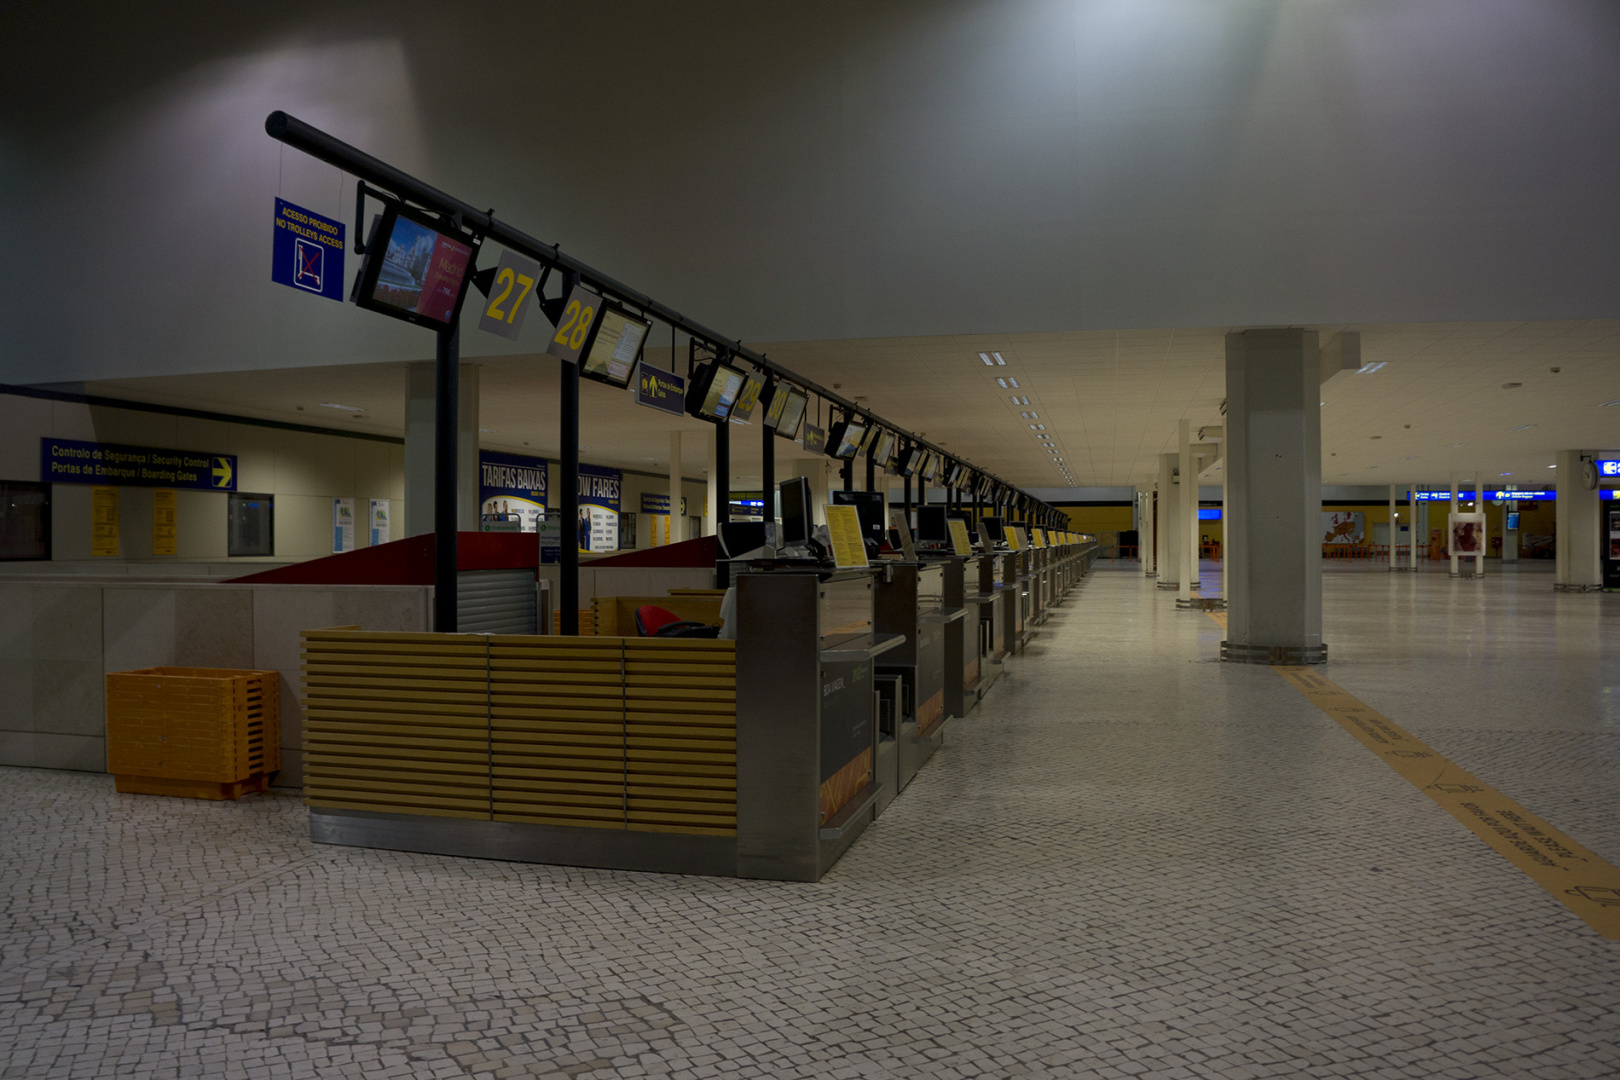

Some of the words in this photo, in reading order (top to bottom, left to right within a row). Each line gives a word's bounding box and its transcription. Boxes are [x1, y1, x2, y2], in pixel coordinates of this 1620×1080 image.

[276, 217, 286, 229] NO
[287, 221, 318, 241] TROLLEYS
[318, 234, 343, 250] ACCESS
[282, 207, 308, 224] ACESSO
[309, 217, 338, 236] PROIBIDO
[438, 256, 465, 278] Madrid
[486, 267, 534, 324] 27
[554, 300, 593, 350] 28
[737, 379, 761, 412] 29
[768, 389, 787, 420] 30
[52, 445, 91, 459] Controlo
[92, 448, 103, 460] de
[104, 450, 147, 465] Segurança
[152, 453, 183, 468] Security
[183, 456, 210, 468] Control
[52, 461, 80, 474] Portas
[82, 463, 94, 475] de
[95, 464, 136, 479] Embarque
[141, 468, 175, 483] Boarding
[176, 470, 198, 482] Gates
[481, 464, 517, 489] TARIFAS
[517, 469, 546, 491] BAIXAS
[592, 477, 620, 499] FARES
[1533, 837, 1578, 859] PLEASE
